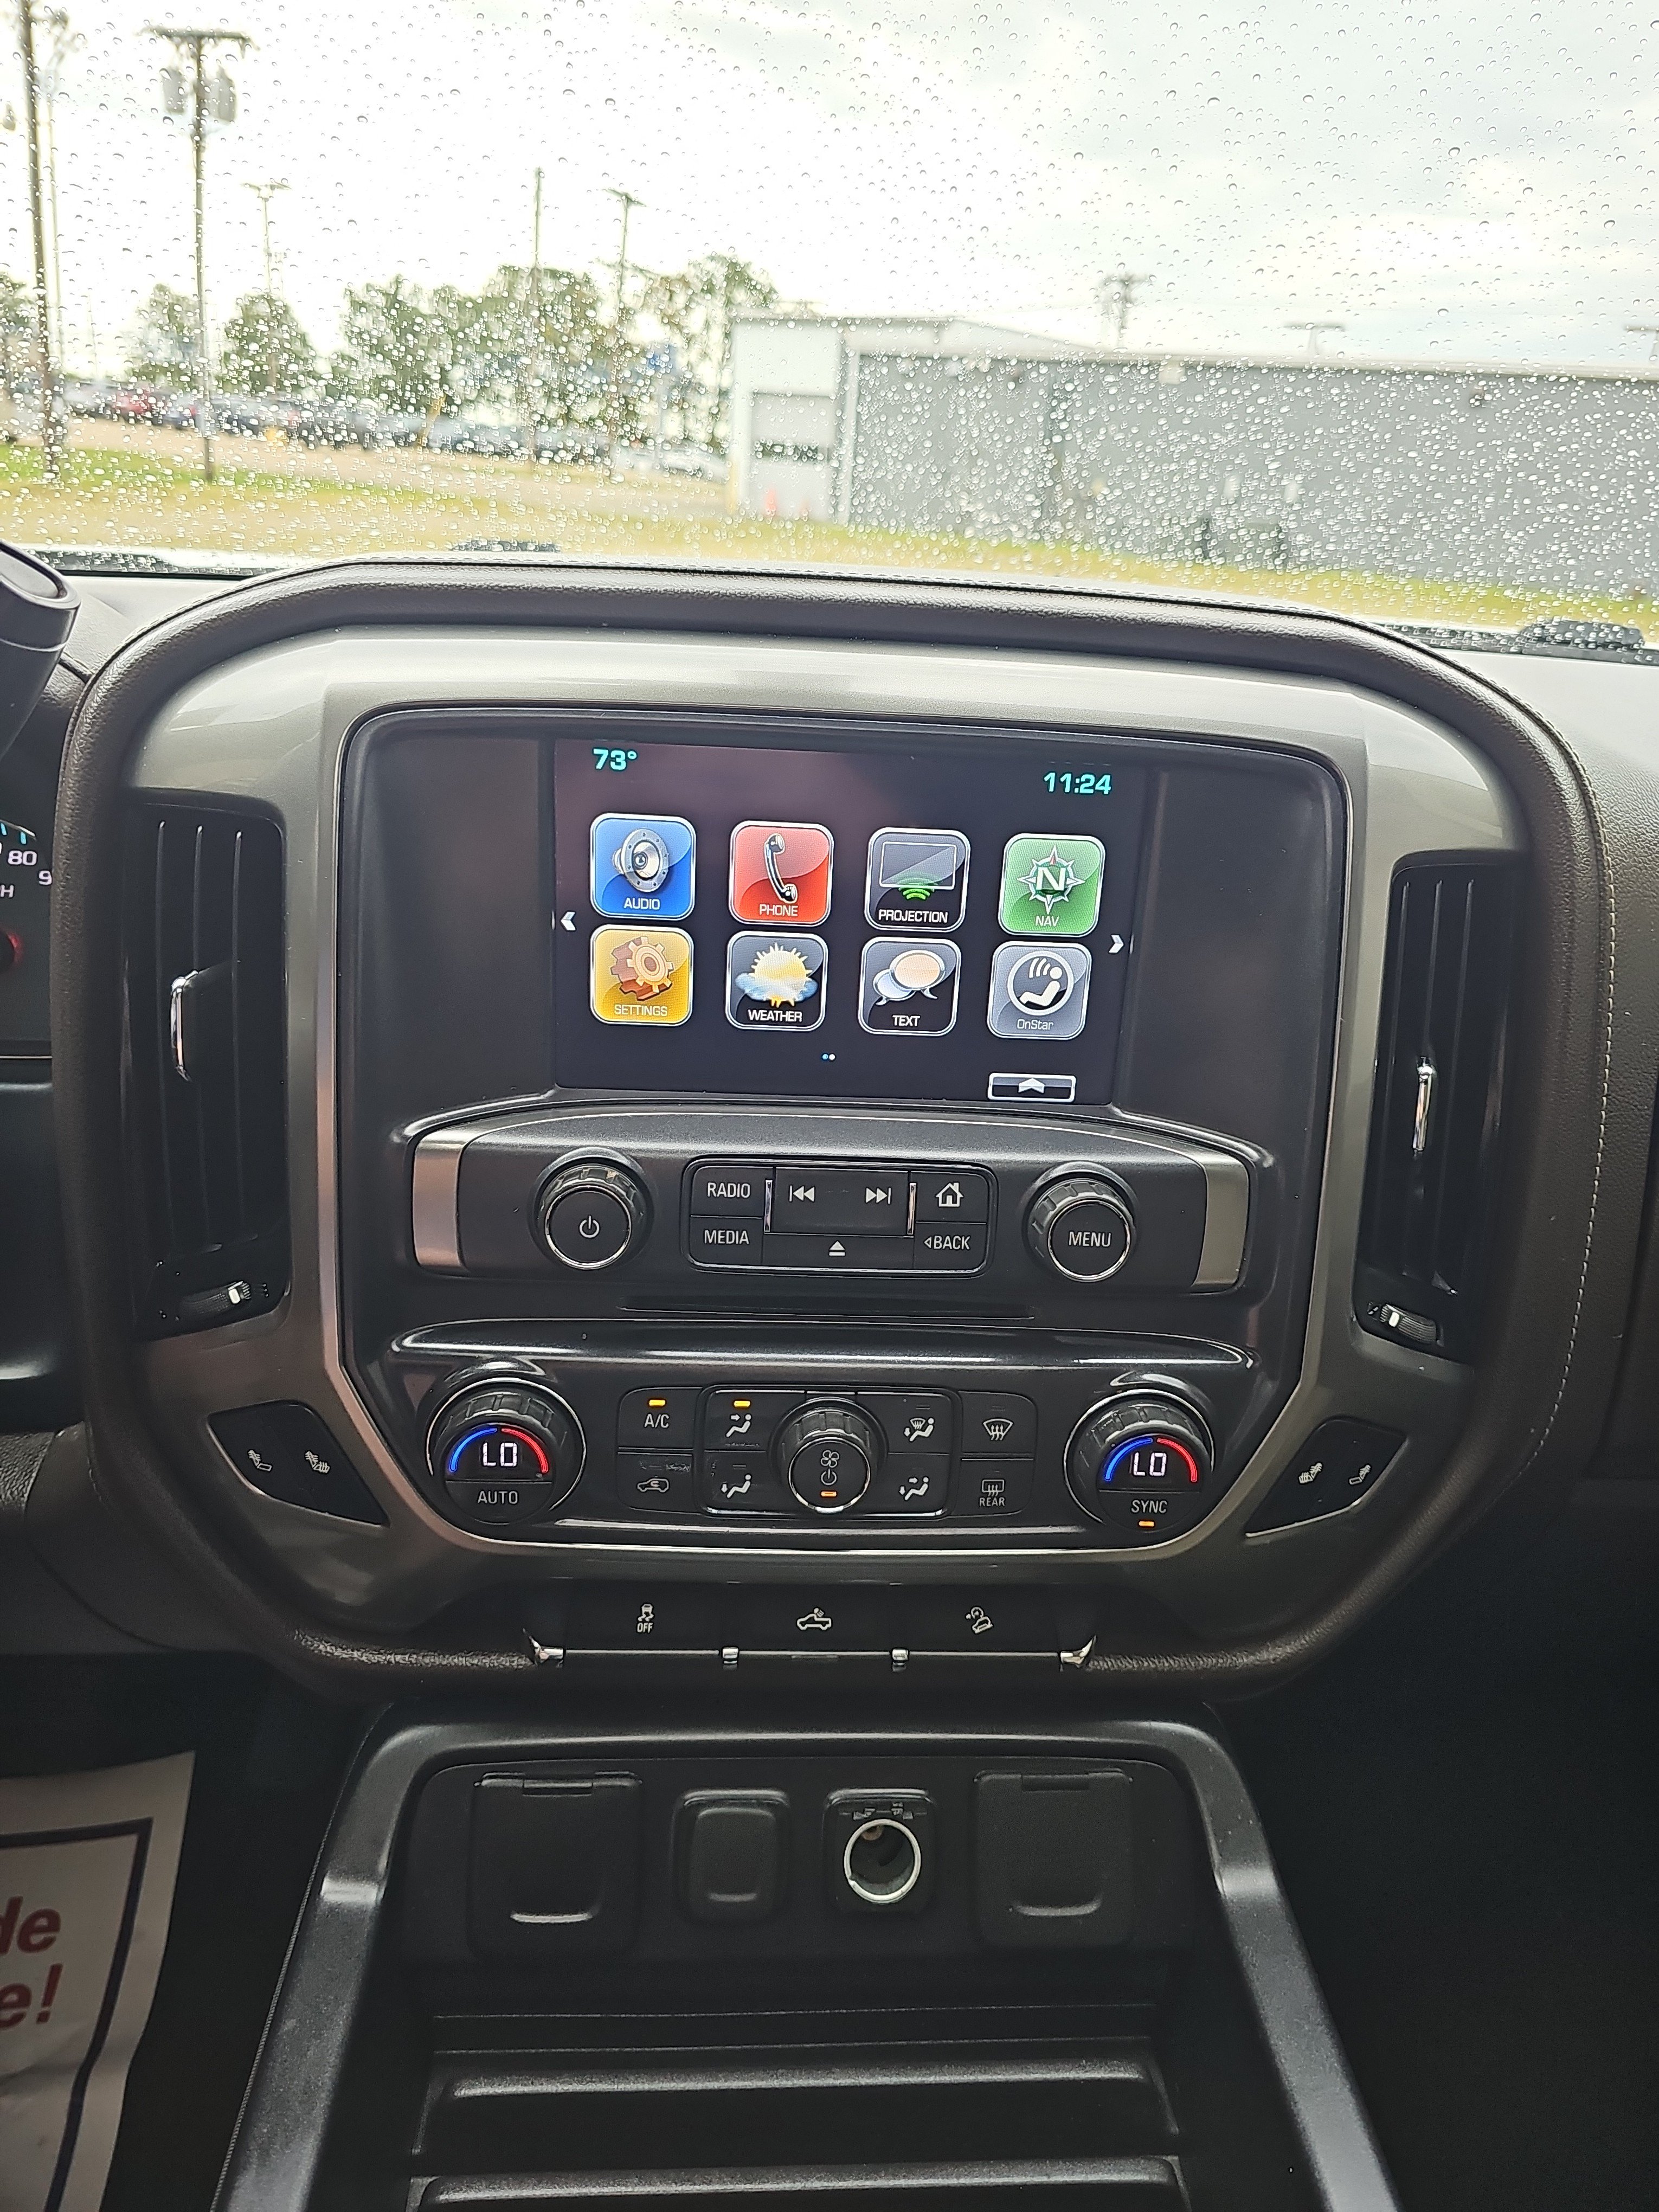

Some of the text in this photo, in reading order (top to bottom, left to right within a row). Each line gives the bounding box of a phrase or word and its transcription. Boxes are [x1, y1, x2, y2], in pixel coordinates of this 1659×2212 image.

[593, 748, 637, 770] 73°
[1044, 772, 1111, 795] 11:24
[8, 850, 37, 866] 80
[1036, 867, 1066, 891] N
[0, 884, 14, 898] H
[623, 897, 661, 911] AUDIO
[759, 904, 799, 917] PHONE
[878, 909, 948, 924] PROJECTION
[1035, 915, 1060, 927] NAV
[614, 1004, 668, 1018] SETTINGS
[748, 1009, 802, 1023] WEATHER
[892, 1015, 921, 1027] TEXT
[1017, 1017, 1054, 1031] OnStar
[706, 1182, 751, 1198] RADIO
[704, 1229, 749, 1245] MEDIA
[934, 1234, 970, 1250] BACK
[1068, 1231, 1111, 1247] MENU
[644, 1413, 670, 1429] A/C
[483, 1442, 517, 1467] LO
[1133, 1452, 1167, 1477] LO
[477, 1490, 518, 1505] AUTO
[979, 1497, 1005, 1507] REAR
[1130, 1500, 1168, 1514] SYNC
[637, 1622, 653, 1634] OFF
